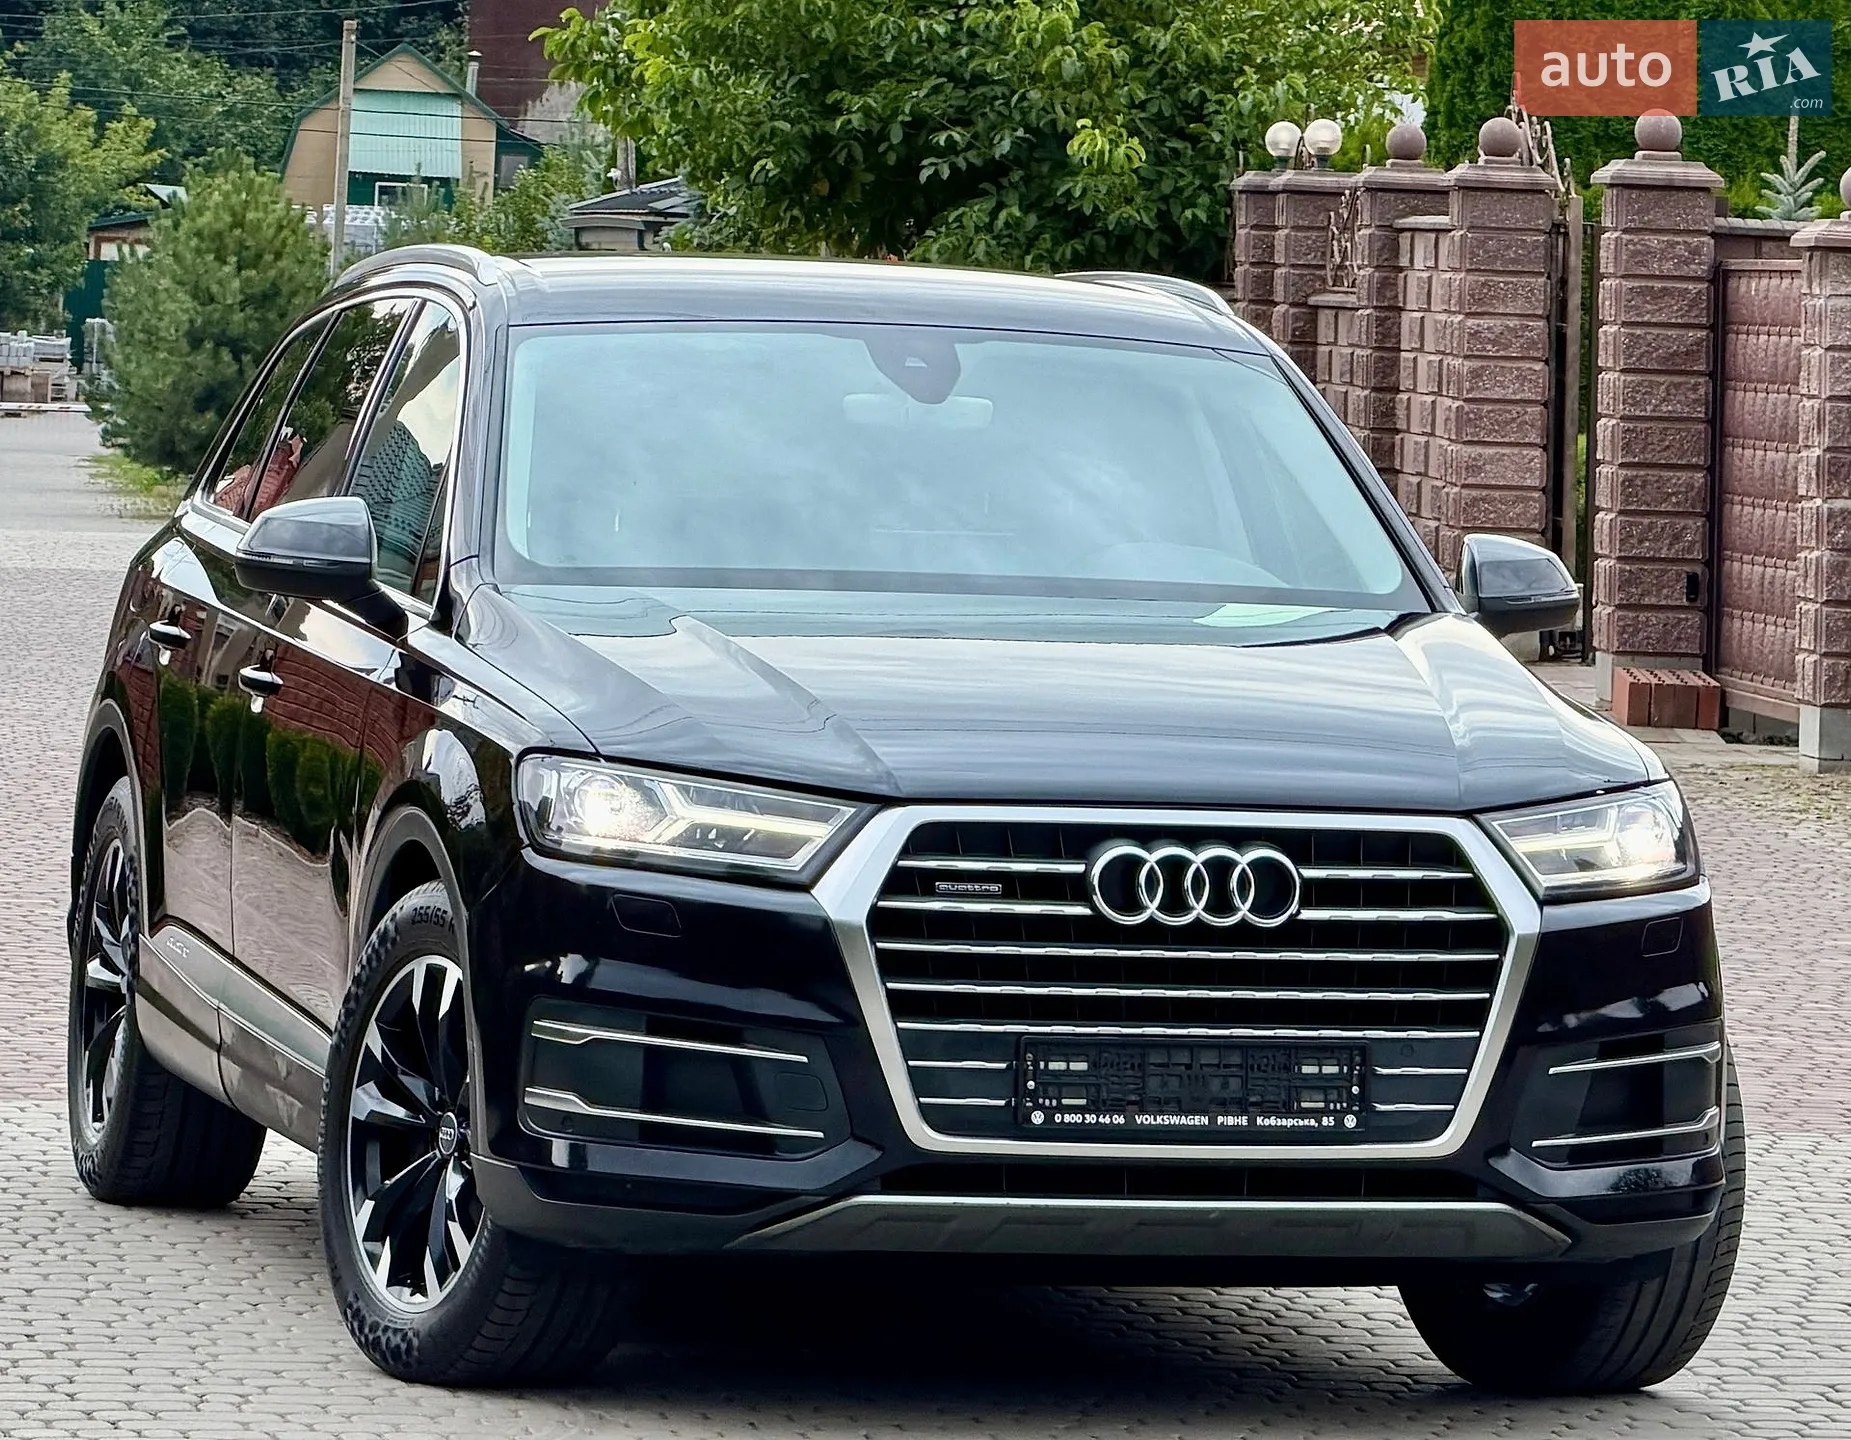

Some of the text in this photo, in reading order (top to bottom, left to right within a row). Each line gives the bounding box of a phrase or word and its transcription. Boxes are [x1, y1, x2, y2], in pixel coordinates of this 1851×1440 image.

[938, 883, 999, 892] quattro
[410, 904, 449, 928] 255/55
[1054, 1113, 1335, 1129] 0 800 30 46 06 VOLKSWAGEN РІВНЕ Кобзарська, 85
